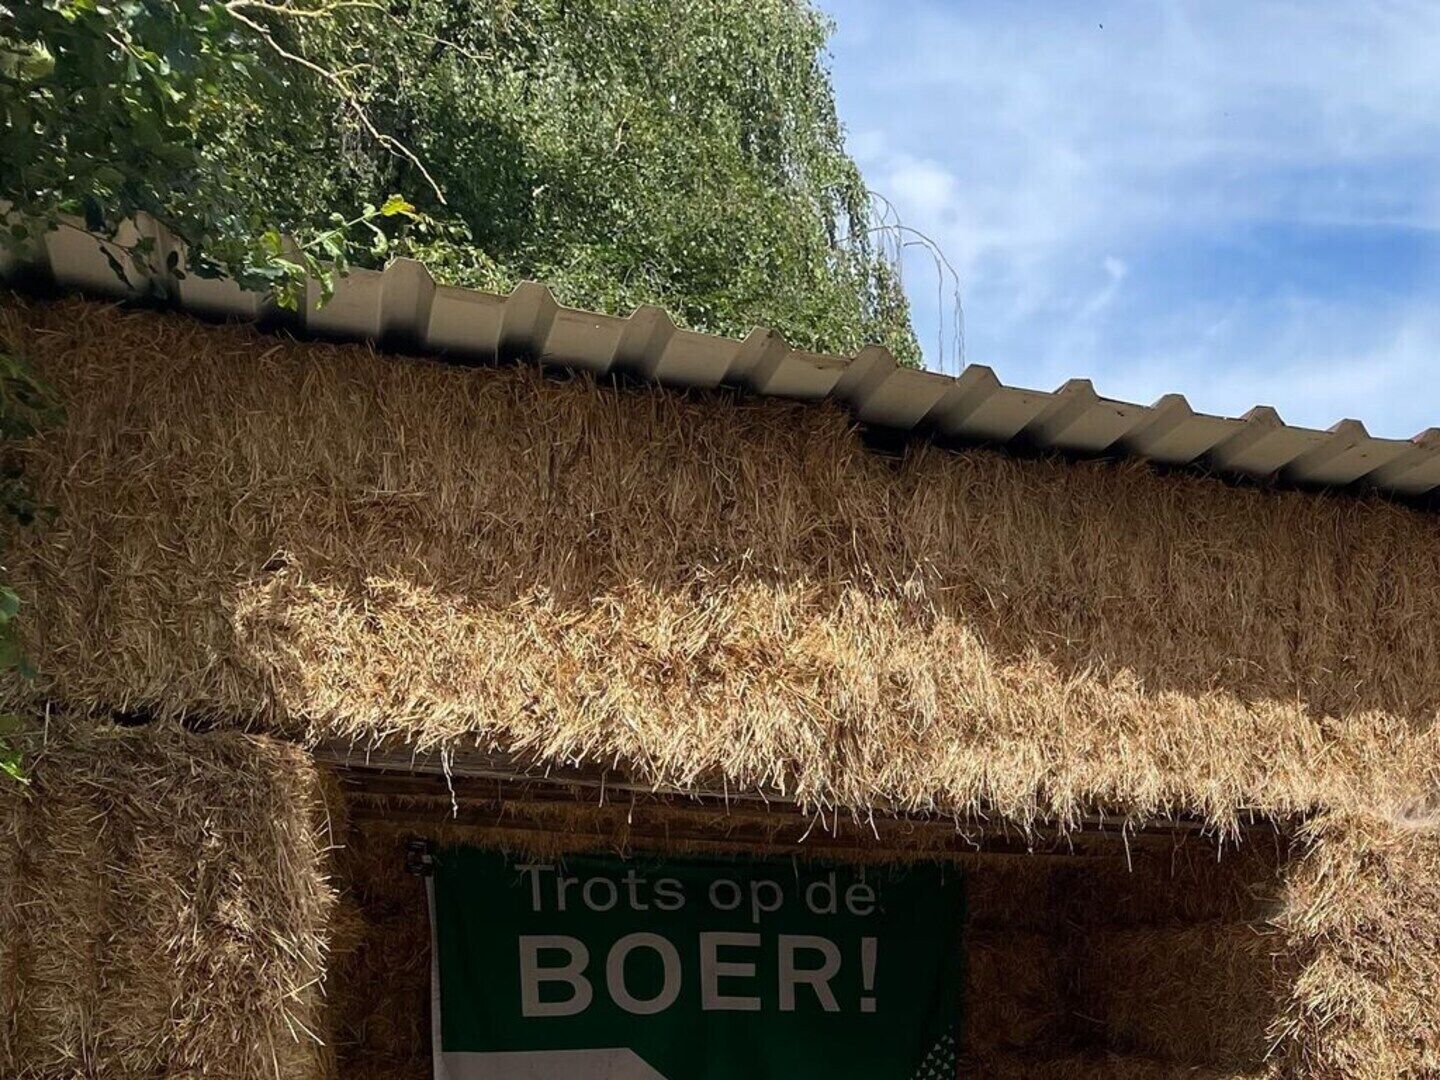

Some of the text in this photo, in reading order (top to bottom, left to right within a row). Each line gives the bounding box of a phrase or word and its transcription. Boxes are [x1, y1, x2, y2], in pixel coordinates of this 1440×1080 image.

[515, 863, 878, 923] Trots op de
[518, 931, 879, 1017] BOER!
